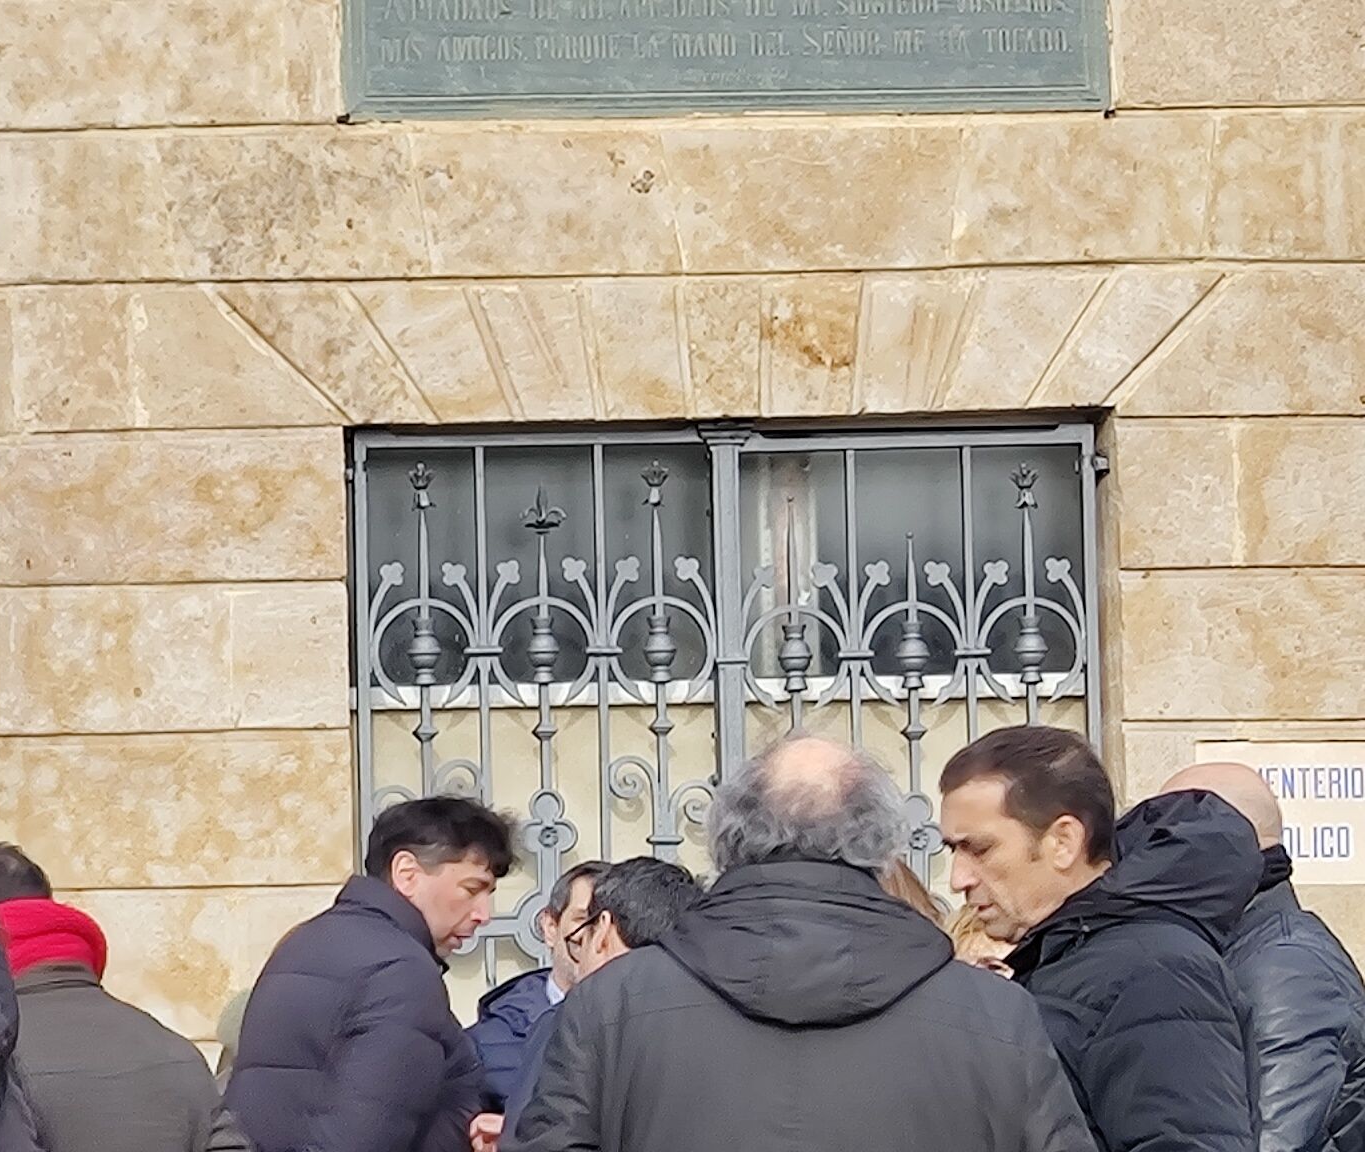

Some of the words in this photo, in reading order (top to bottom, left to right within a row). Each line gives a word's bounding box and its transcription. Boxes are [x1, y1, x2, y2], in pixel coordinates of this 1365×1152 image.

[380, 36, 424, 62] MIS
[672, 31, 737, 58] MANO
[748, 30, 790, 57] DEL
[893, 29, 926, 55] ME
